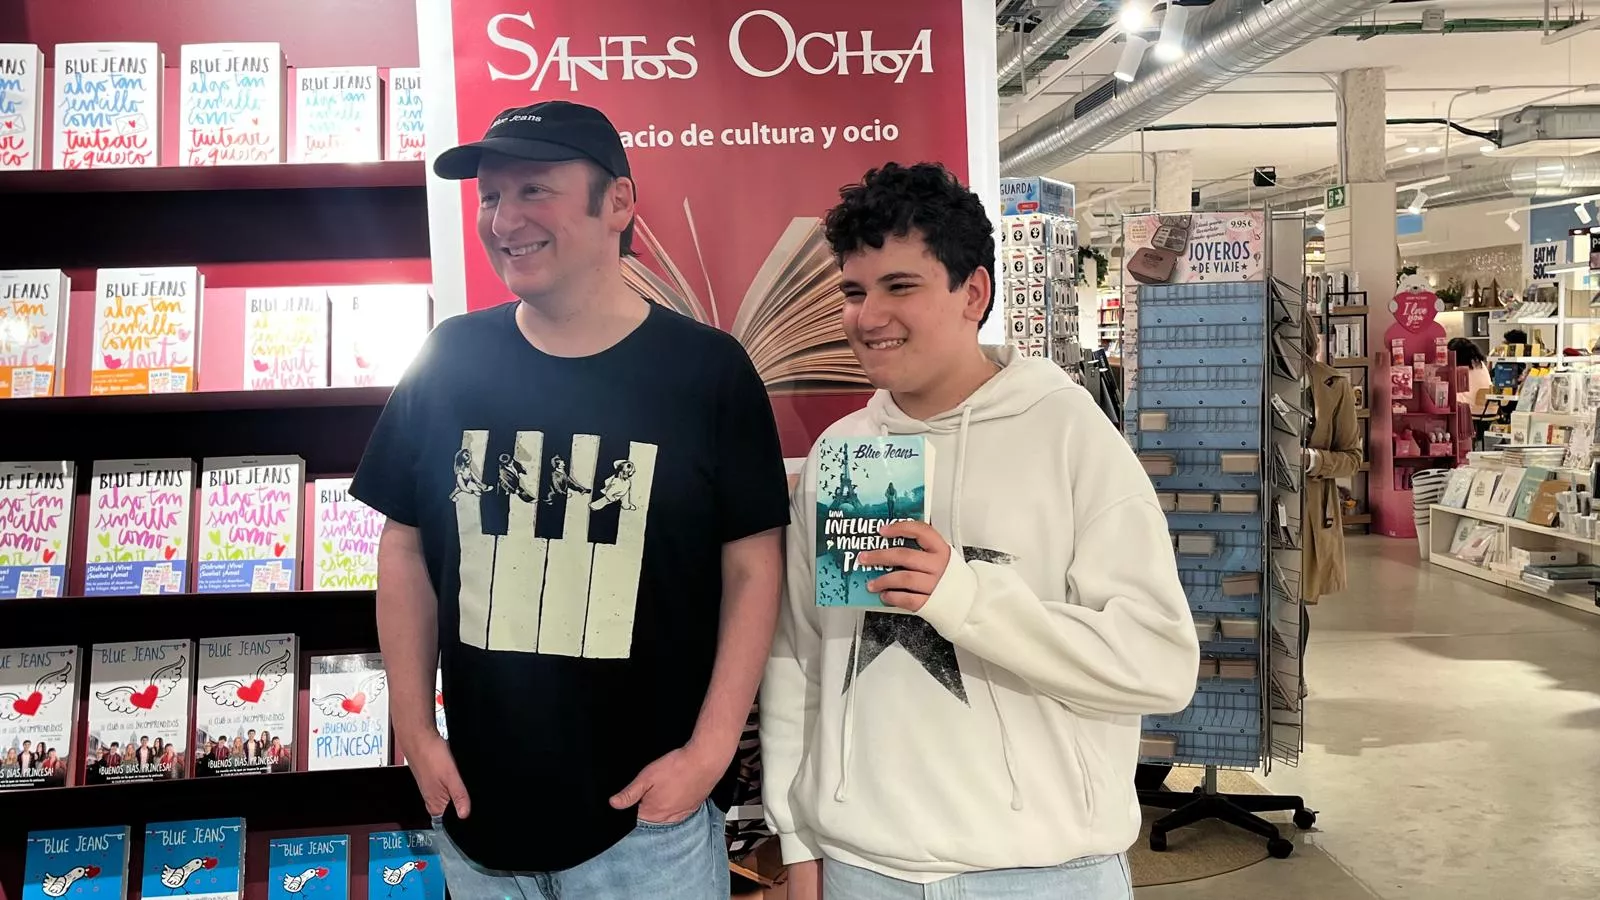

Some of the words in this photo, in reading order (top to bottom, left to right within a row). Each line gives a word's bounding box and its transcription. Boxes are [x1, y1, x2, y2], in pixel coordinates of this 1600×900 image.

[65, 58, 99, 75] BLUE
[100, 56, 148, 74] JEANS
[190, 58, 221, 75] BLUE
[225, 56, 270, 74] JEANS
[64, 72, 108, 102] algo
[108, 73, 147, 92] tan
[301, 76, 329, 91] BLUE
[333, 75, 373, 90] JEANS
[620, 124, 674, 148] acio
[680, 123, 714, 147] de
[720, 121, 815, 146] cultura
[821, 126, 837, 149] y
[843, 119, 899, 143] ocio
[1188, 240, 1250, 261] JOYEROS
[1534, 247, 1545, 264] EAT
[1546, 245, 1557, 262] MY
[1199, 263, 1210, 274] DE
[1214, 262, 1240, 273] VIAJE
[4, 283, 50, 299] JEANS
[106, 282, 139, 298] BLUE
[142, 280, 187, 297] JEANS
[853, 444, 881, 459] Blue
[884, 443, 919, 459] Jeans
[16, 472, 65, 490] JEANS
[100, 472, 134, 490] BLUE
[137, 469, 184, 488] JEANS
[209, 469, 242, 487] BLUE
[245, 466, 292, 485] JEANS
[828, 510, 844, 518] UNA
[836, 535, 889, 550] MUERTA
[892, 538, 905, 547] EN
[101, 648, 126, 664] BLUE
[132, 646, 166, 661] JEANS
[208, 642, 232, 657] BLUE
[238, 640, 271, 656] JEANS
[17, 651, 51, 668] JEANS
[317, 733, 383, 758] PRINCESA!
[44, 838, 70, 854] BLUE
[75, 834, 109, 852] JEANS
[161, 829, 187, 846] BLUE
[192, 827, 226, 844] JEANS
[382, 836, 402, 850] BLUE
[406, 834, 433, 848] JEANS
[283, 843, 303, 857] BLUE
[307, 841, 335, 855] JEANS
